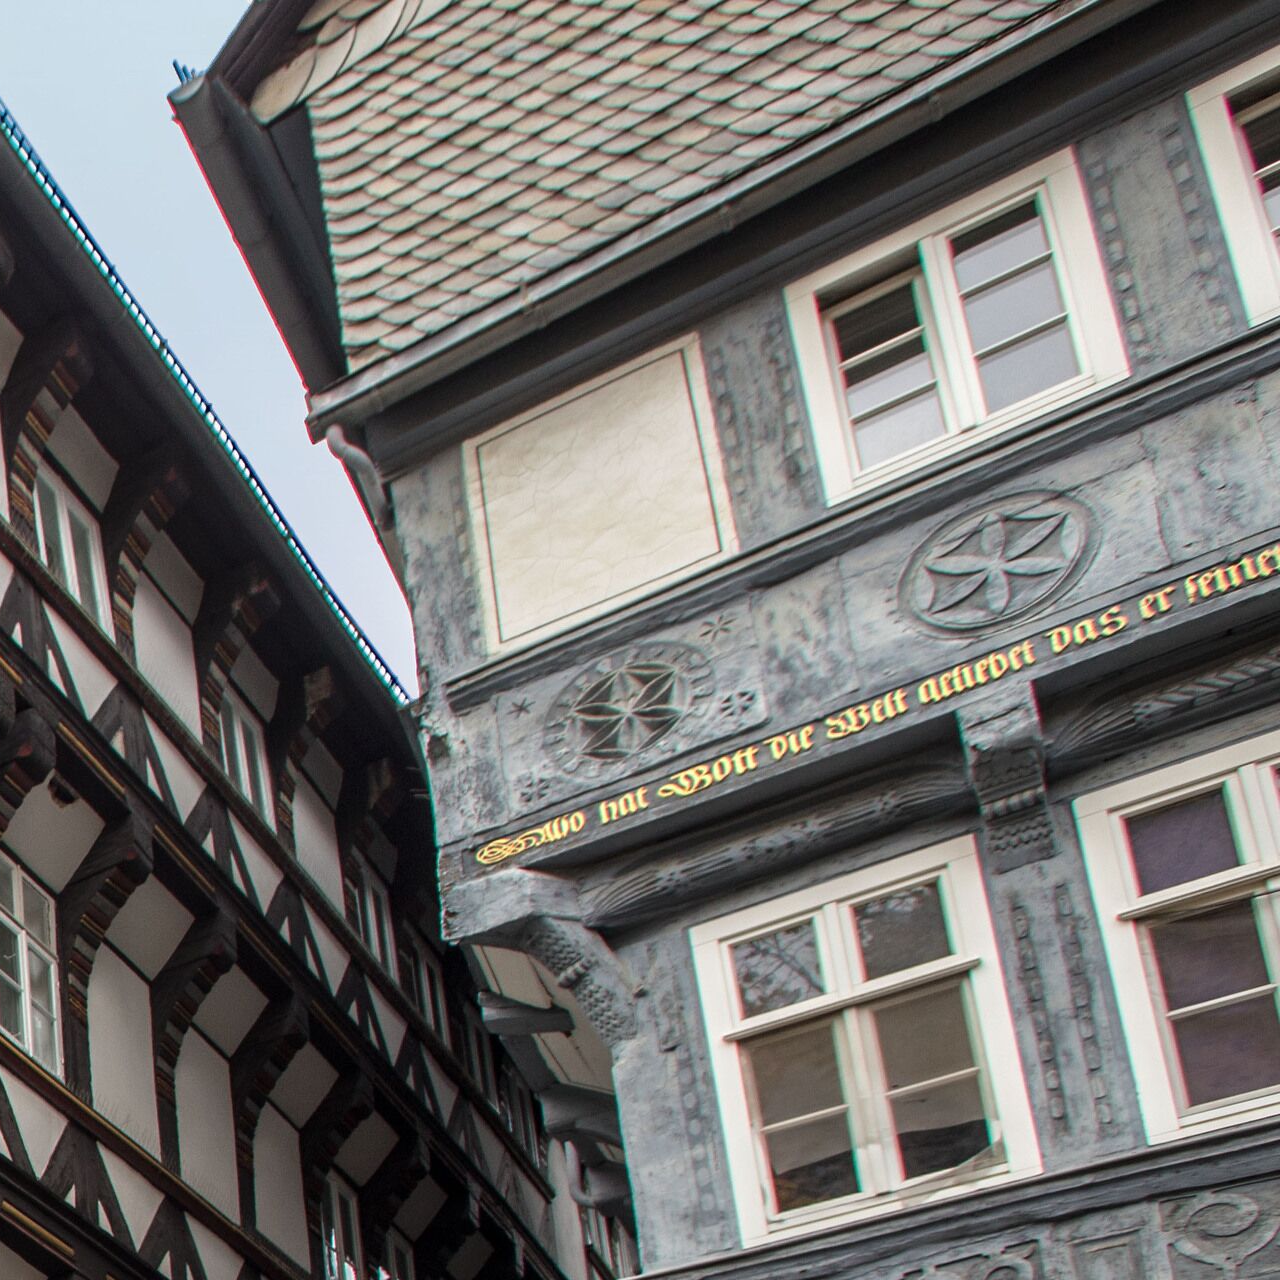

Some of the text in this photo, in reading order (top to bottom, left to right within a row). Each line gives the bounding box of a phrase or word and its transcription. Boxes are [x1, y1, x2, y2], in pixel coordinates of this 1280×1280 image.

[598, 786, 650, 825] hat
[762, 724, 815, 761] die
[824, 687, 910, 740] Welt
[1137, 584, 1178, 620] er
